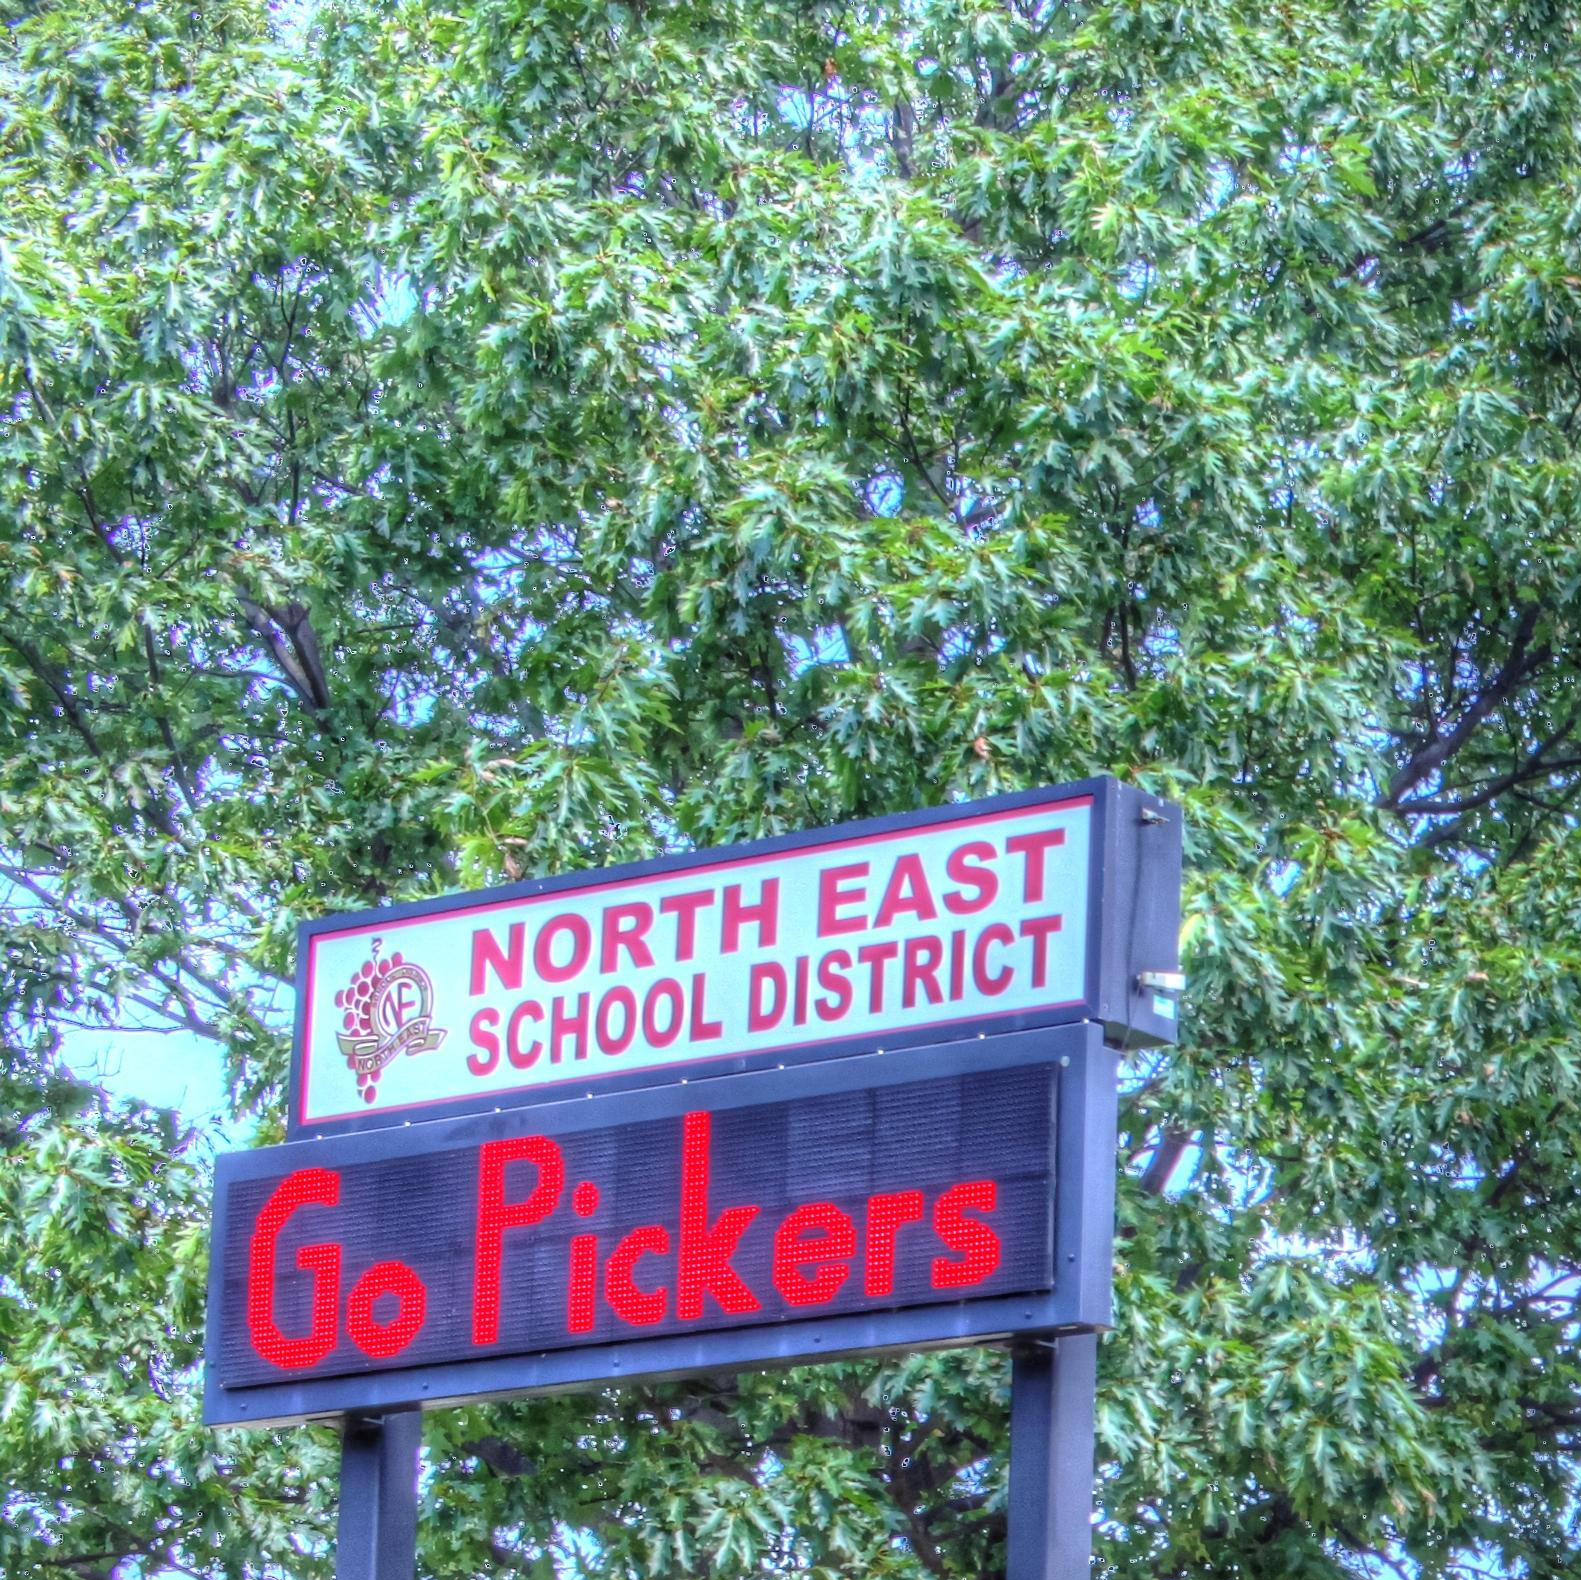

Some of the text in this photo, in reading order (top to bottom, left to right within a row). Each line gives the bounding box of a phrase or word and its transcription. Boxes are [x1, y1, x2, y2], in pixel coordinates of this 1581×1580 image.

[473, 831, 1064, 996] NORTH EAST
[357, 1021, 427, 1072] NORTH EAST
[470, 917, 1061, 1075] SCHOOL DISTRICT
[248, 1112, 1001, 1370] Go Pickers
